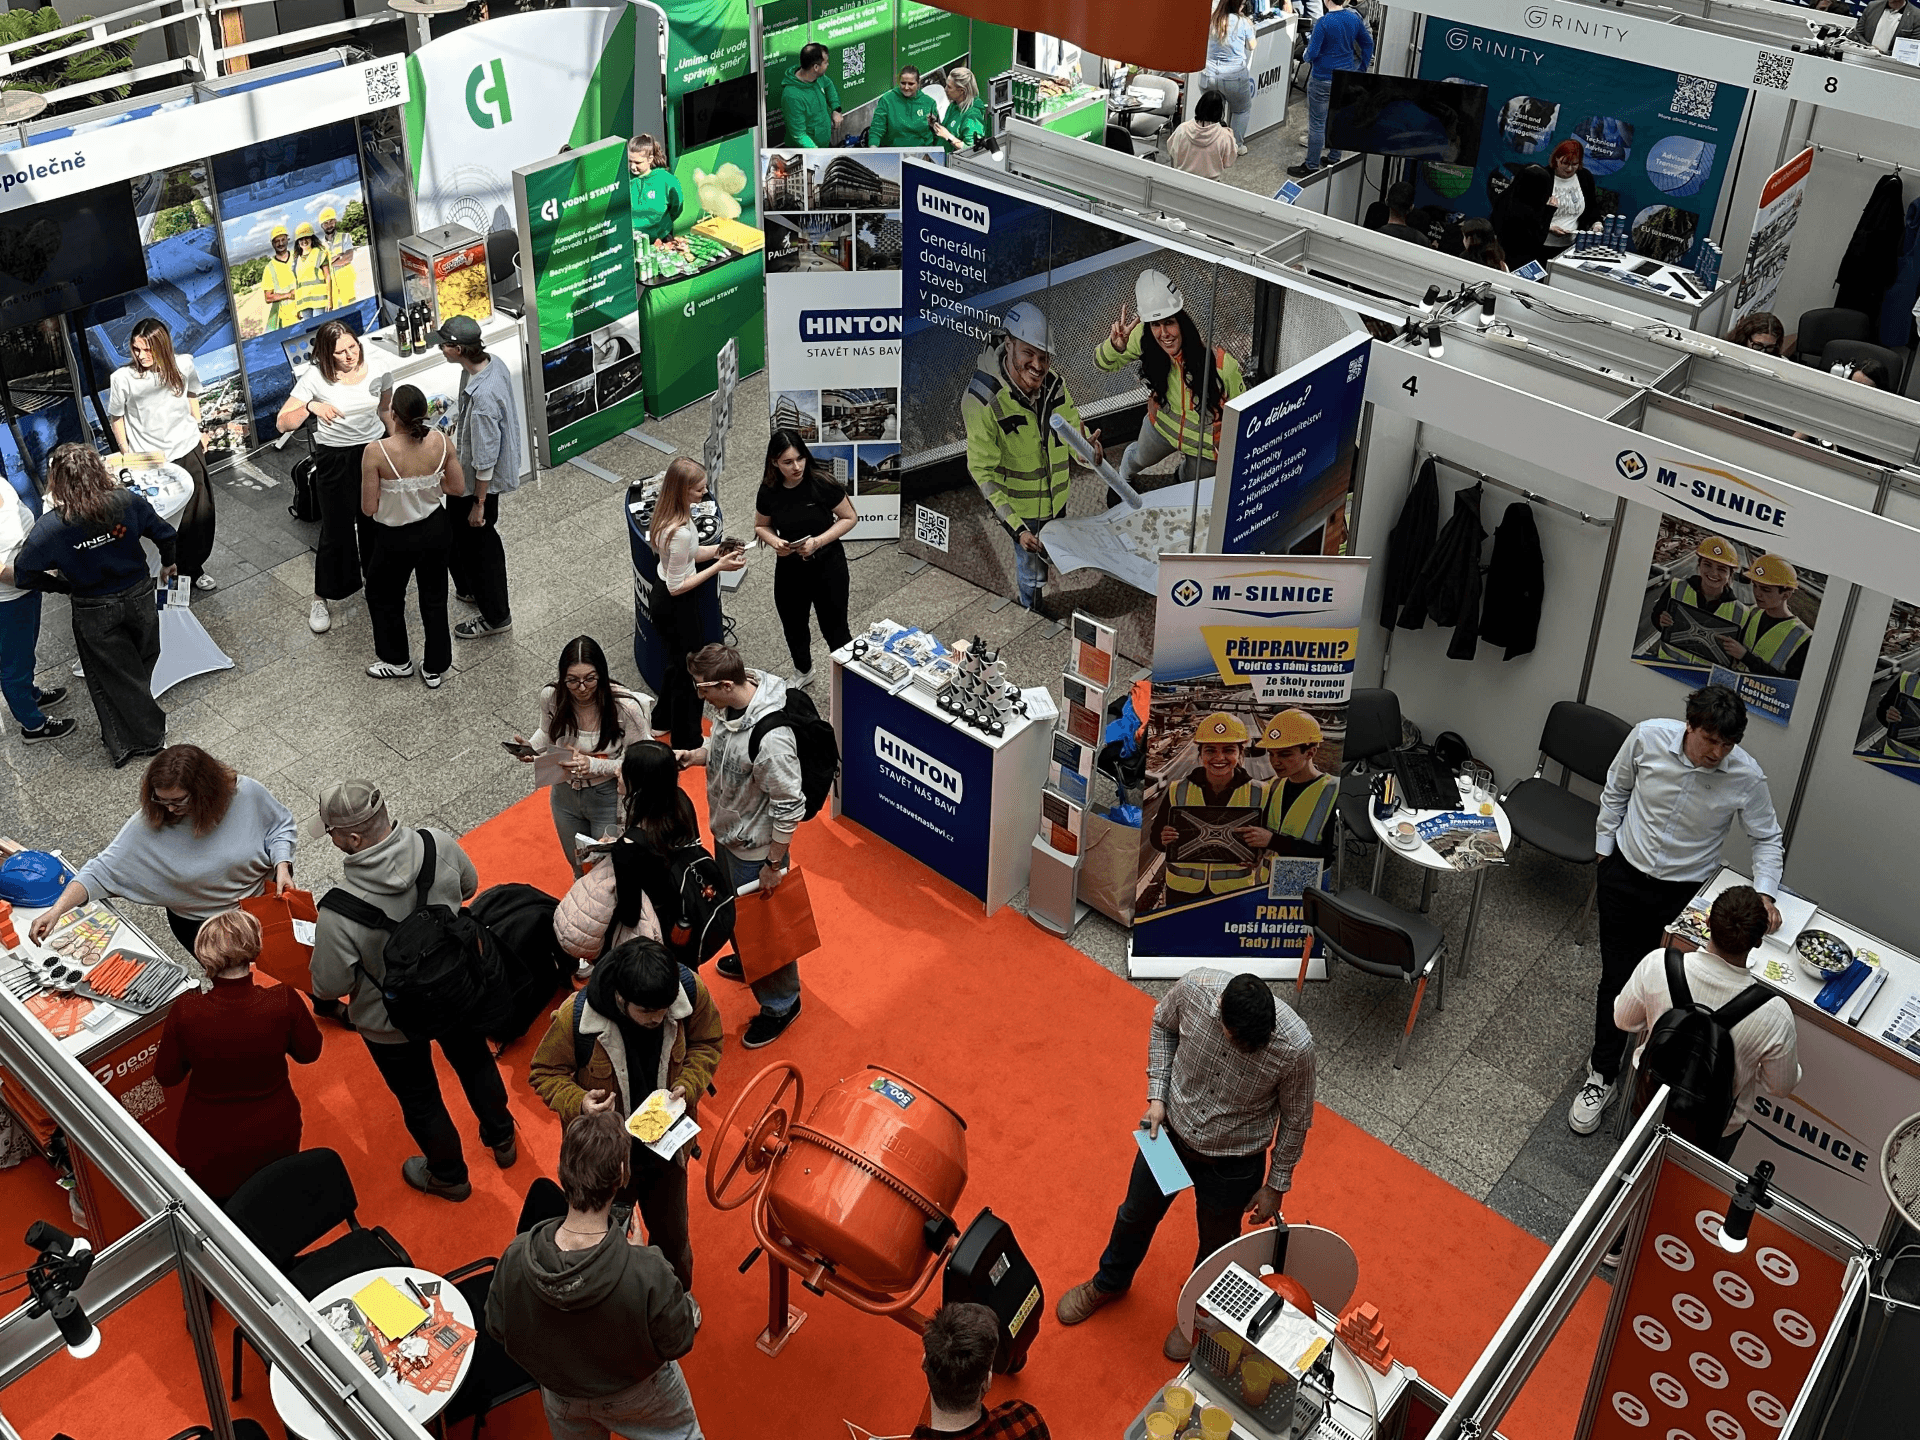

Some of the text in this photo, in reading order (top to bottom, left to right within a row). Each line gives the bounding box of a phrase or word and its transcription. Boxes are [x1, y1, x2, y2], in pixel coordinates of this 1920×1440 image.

[1524, 5, 1629, 43] GRINITY
[710, 47, 725, 60] dát
[726, 38, 748, 55] vodě
[1445, 28, 1545, 66] GRINITY
[682, 63, 718, 84] správný
[1257, 65, 1282, 90] KAMI
[1256, 82, 1280, 98] PROFIT
[1824, 76, 1839, 94] 8
[1506, 117, 1546, 133] Commercial
[1513, 111, 1542, 124] Cost and
[1657, 112, 1672, 121] More
[1672, 116, 1688, 125] about
[1697, 122, 1719, 132] services
[1504, 125, 1545, 141] Management
[1585, 134, 1617, 148] Technical
[1585, 143, 1614, 157] Advisory
[1661, 151, 1693, 164] Advisory
[0, 150, 87, 193] polečně
[1491, 177, 1511, 189] Energ
[561, 181, 620, 209] VODNÍ STAVBY
[921, 192, 986, 227] HINTON
[1640, 225, 1685, 244] EU taxonomy
[919, 228, 986, 263] Generální
[919, 248, 988, 284] dodavatel
[919, 269, 964, 294] staveb
[919, 288, 1001, 328] v pozemním
[806, 316, 903, 335] HINTON
[919, 308, 993, 343] stavitelství
[807, 345, 902, 358] STAVĚT NÁS BAV
[1401, 375, 1419, 398] 4
[1245, 384, 1312, 439] Co děláme?
[1251, 409, 1323, 458] Pozemní stavitelství
[1247, 447, 1307, 489] Zakládání staveb
[1249, 449, 1283, 474] Monolity
[1245, 464, 1304, 505] Hliníkové fasády
[1656, 466, 1787, 528] M-SILNICE
[857, 514, 899, 522] nton.cz
[1243, 502, 1263, 520] Prefa
[1232, 510, 1280, 544] www.hinton.cz
[73, 532, 111, 550] VINCI
[1212, 585, 1334, 603] M-SILNICE
[1225, 636, 1350, 659] PŘIPRAVENI?
[1237, 660, 1346, 673] Pojďte s námi stavět.
[1265, 675, 1345, 688] Ze školy rovnou
[1740, 684, 1760, 698] Lepší
[1743, 676, 1777, 696] PRAXE?
[1262, 687, 1344, 700] na velké stavby!
[880, 735, 957, 794] HINTON
[879, 764, 957, 816] STAVĚT NÁS BAVÍ
[878, 792, 955, 843] www.stavetnasbavi.cz
[1255, 905, 1304, 920] PRAX
[1224, 921, 1309, 935] Lepší kariéra
[1238, 936, 1270, 949] Tady
[1270, 936, 1281, 949] ji
[116, 1040, 161, 1078] geos
[130, 1055, 154, 1074] GROUP
[889, 1087, 912, 1105] 500
[1753, 1095, 1870, 1173] SILNICE
